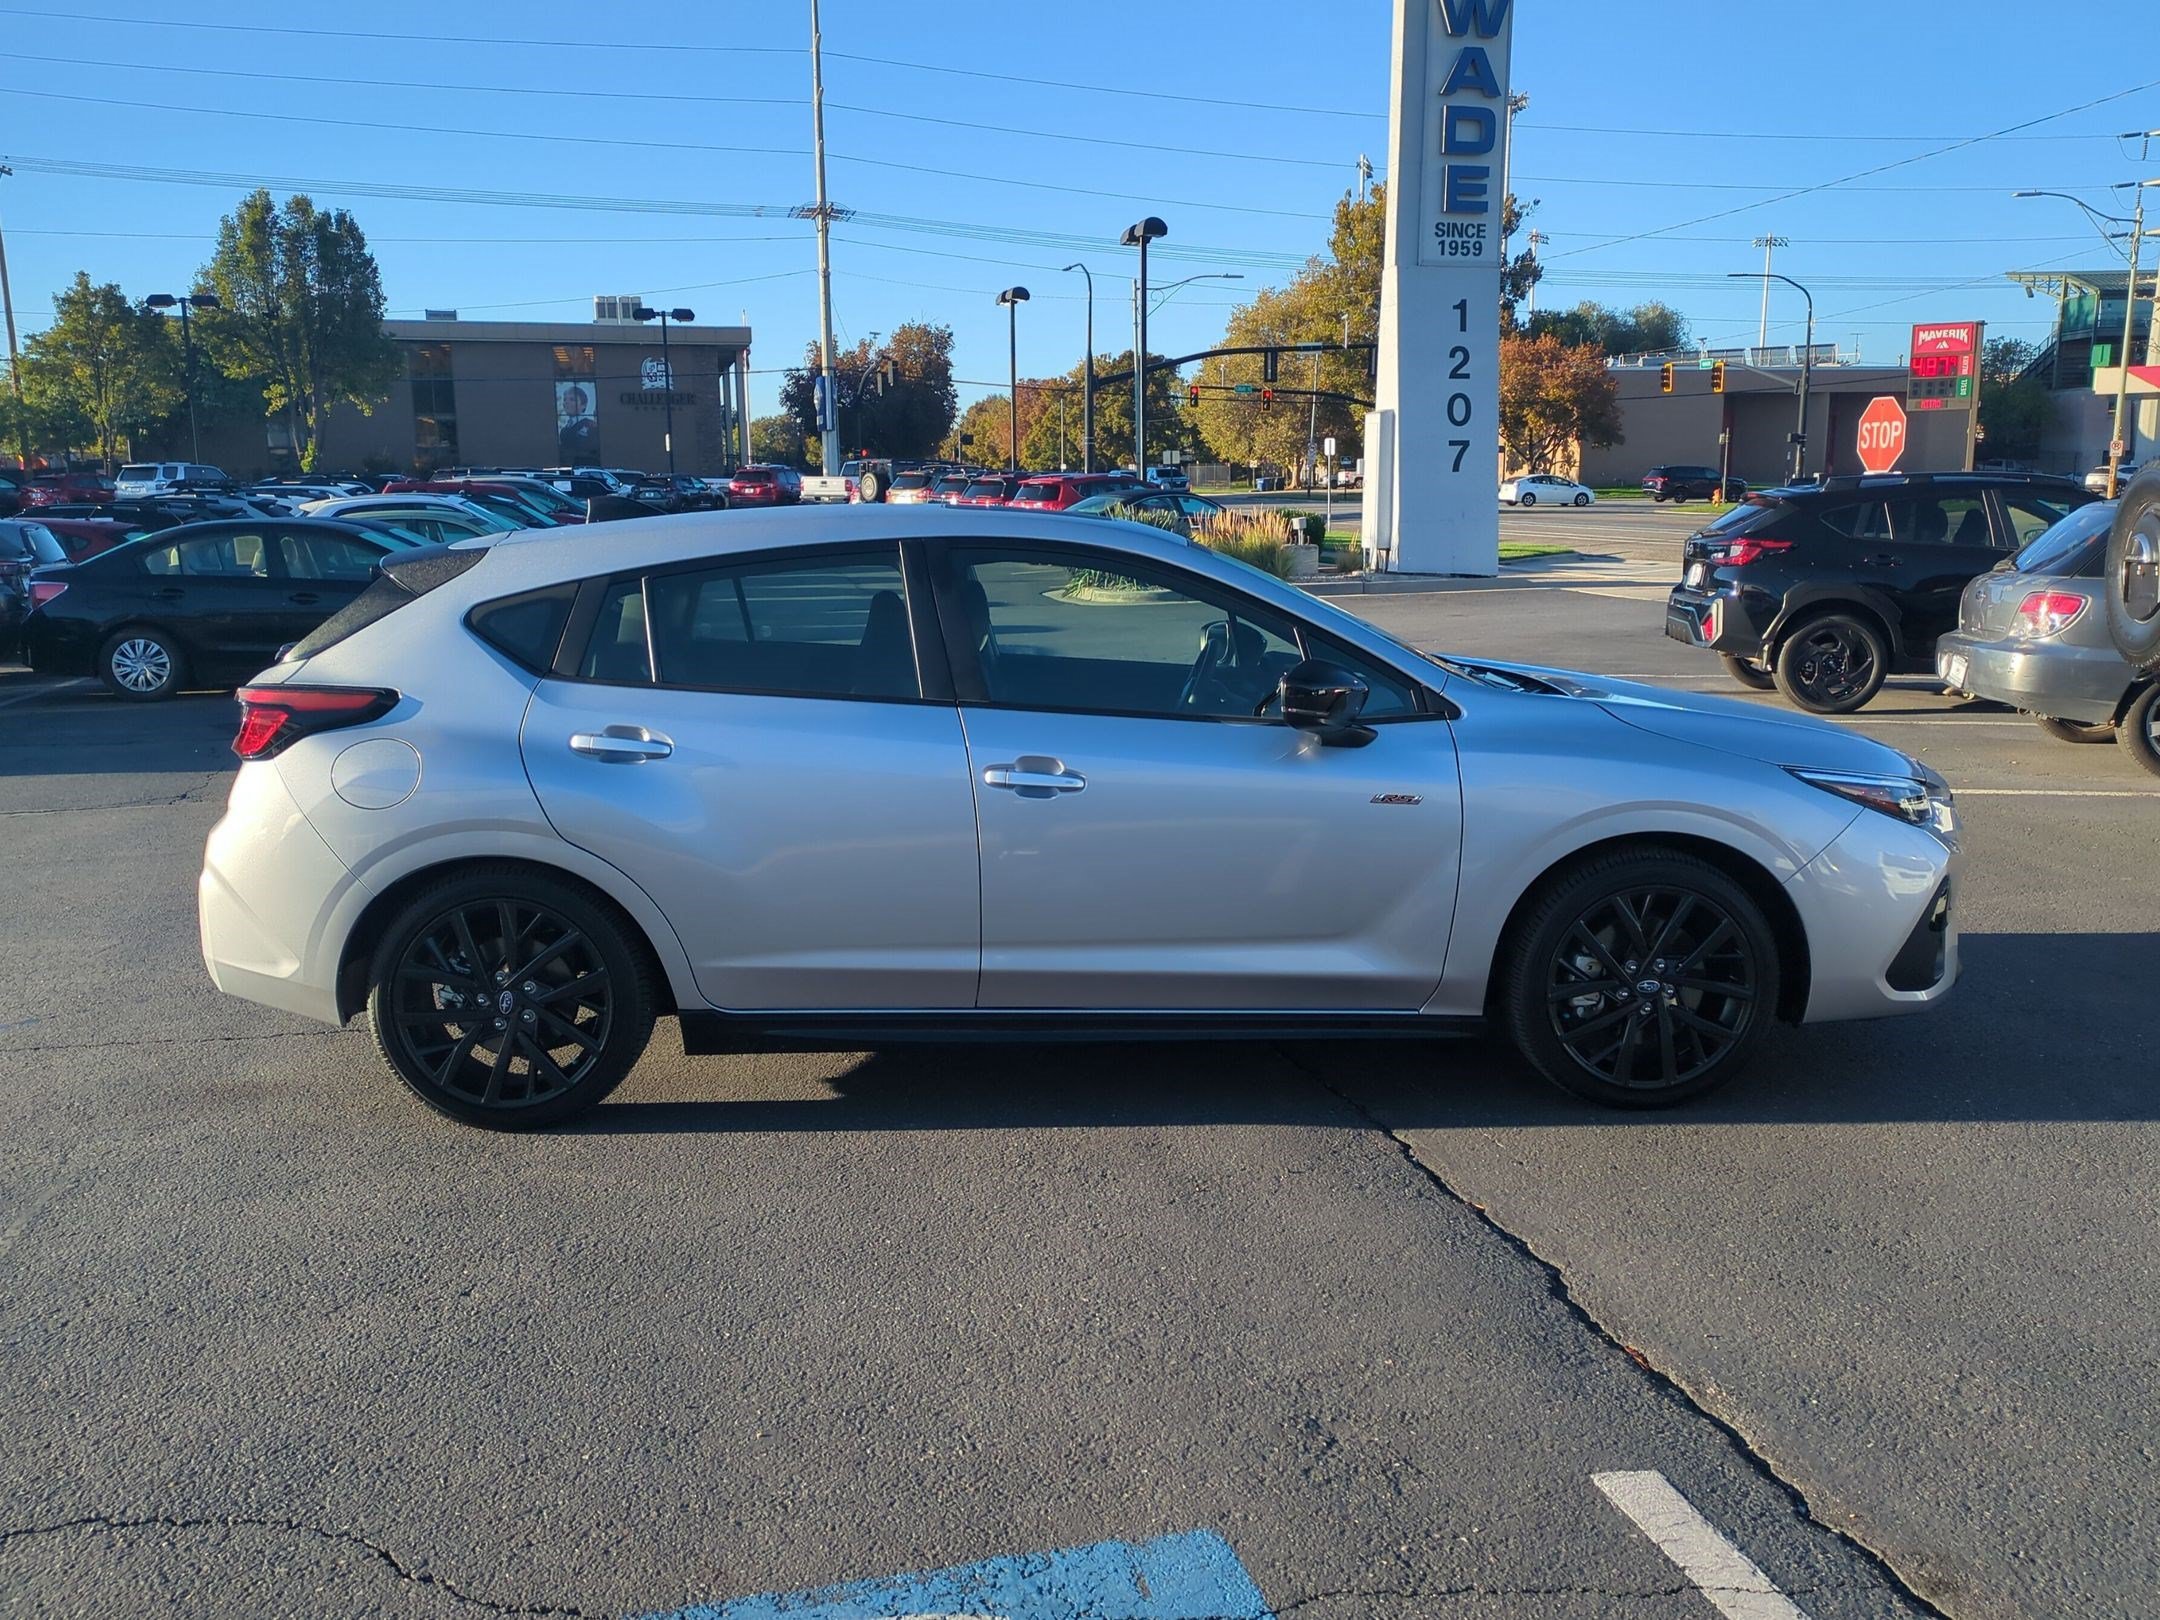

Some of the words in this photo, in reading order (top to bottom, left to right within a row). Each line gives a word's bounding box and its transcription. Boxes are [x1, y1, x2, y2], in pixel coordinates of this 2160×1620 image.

[1440, 0, 1508, 214] WADE
[1434, 221, 1487, 239] SINCE
[1437, 240, 1483, 257] 1959
[1918, 327, 1969, 346] MAVERIK
[1446, 298, 1472, 473] 1207
[620, 392, 697, 405] CHALLEGER
[1860, 421, 1902, 449] STOP
